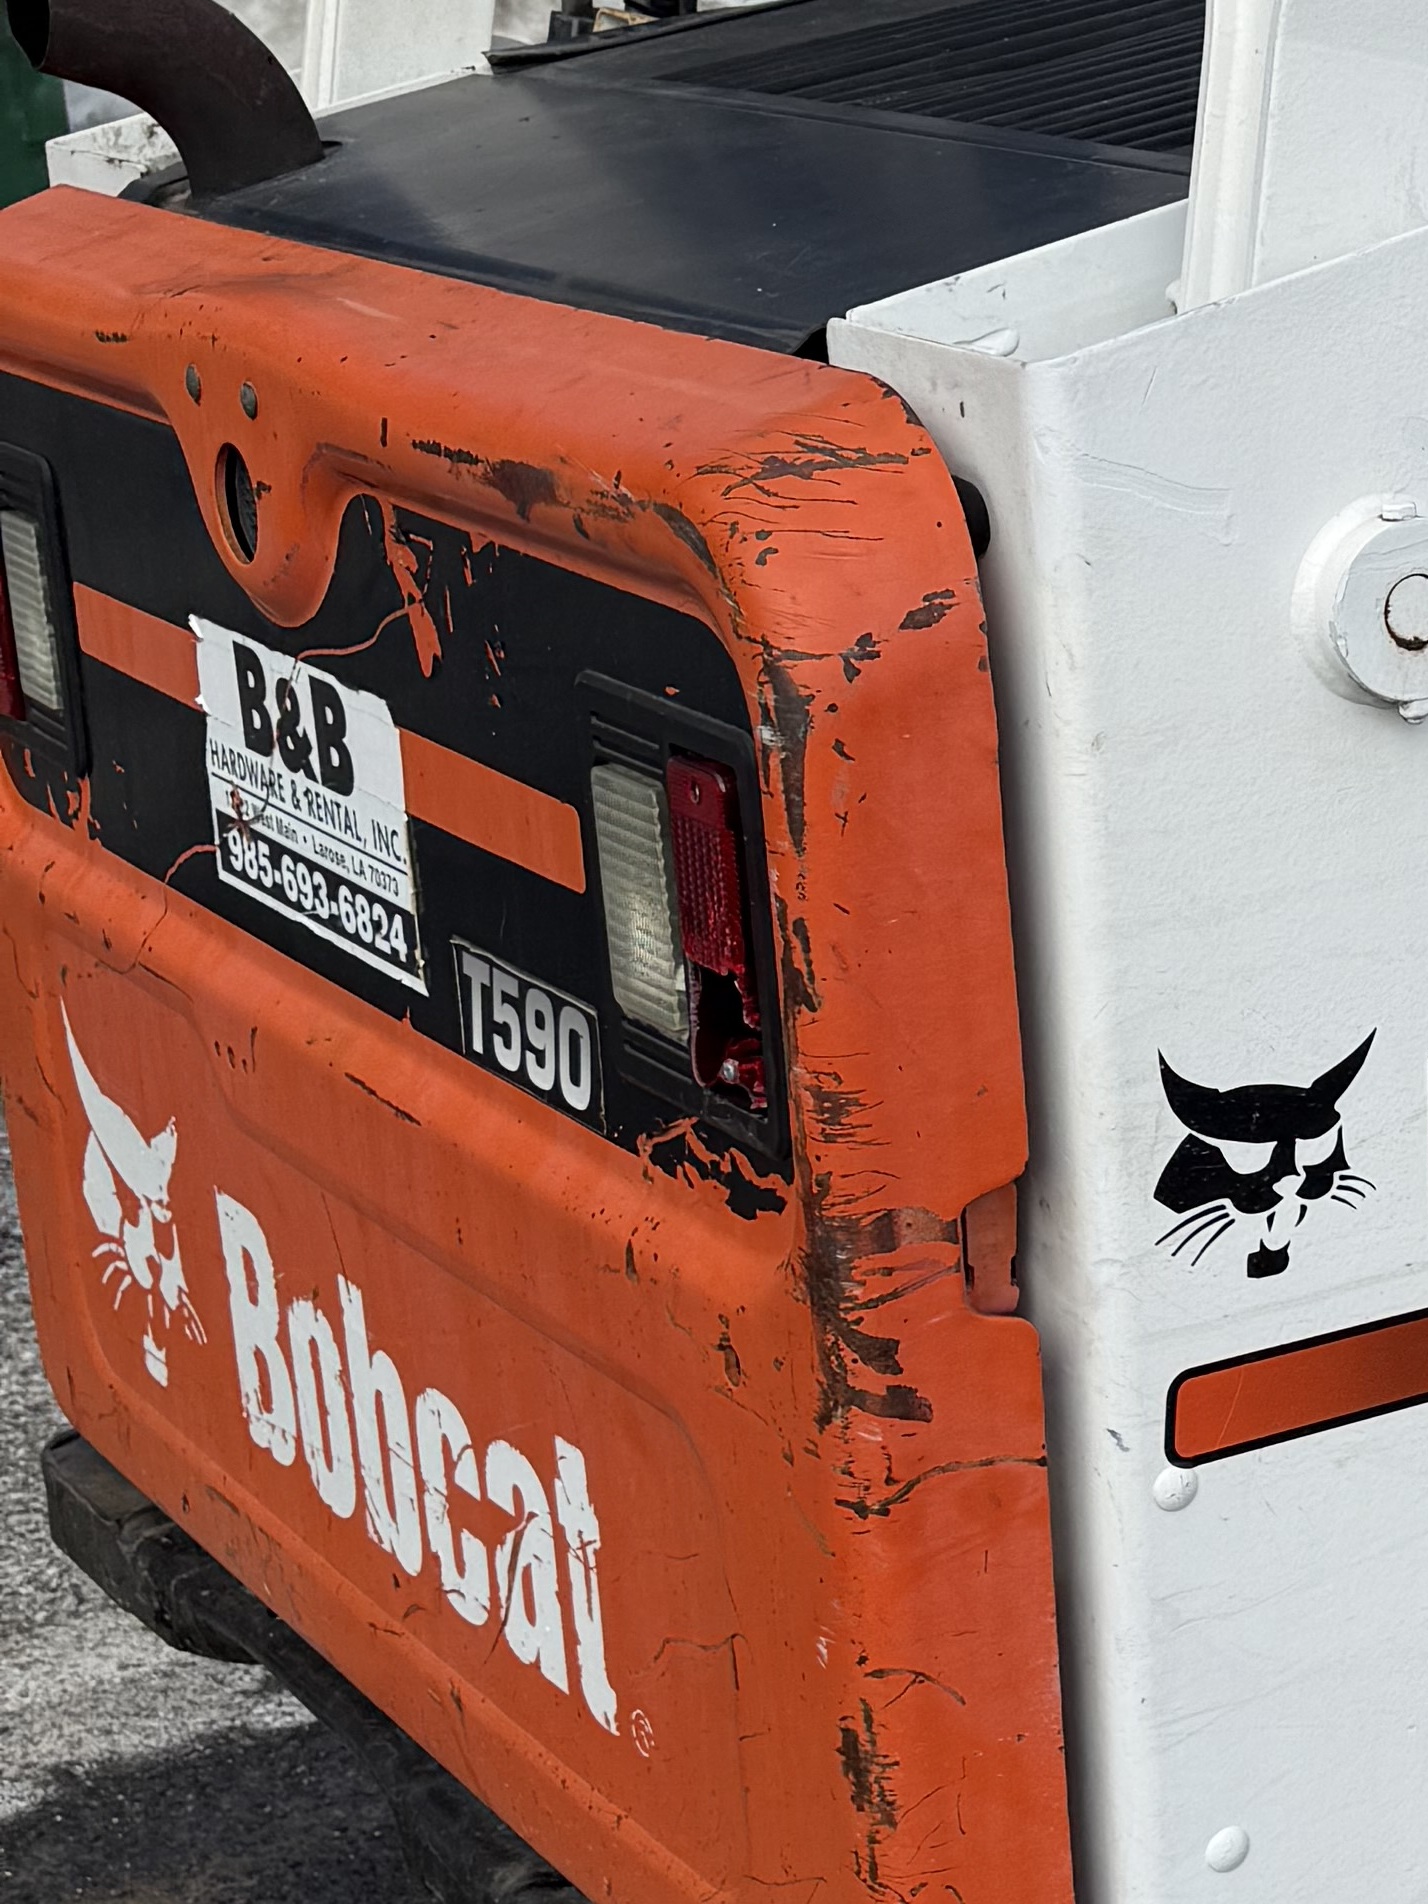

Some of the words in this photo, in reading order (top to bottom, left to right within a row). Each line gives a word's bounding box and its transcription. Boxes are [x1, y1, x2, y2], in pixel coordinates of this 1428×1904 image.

[232, 640, 355, 797] B&B
[209, 738, 286, 804] HARDWARE
[291, 779, 302, 812] &
[303, 787, 367, 850] RENTAL,
[371, 819, 407, 865] INC.
[275, 815, 300, 844] Main
[311, 834, 350, 874] Larose,
[351, 855, 367, 881] LA
[367, 864, 399, 897] 70373
[226, 828, 409, 963] 985-693-6824
[462, 950, 591, 1111] T590
[214, 1184, 621, 1736] Bobcat
